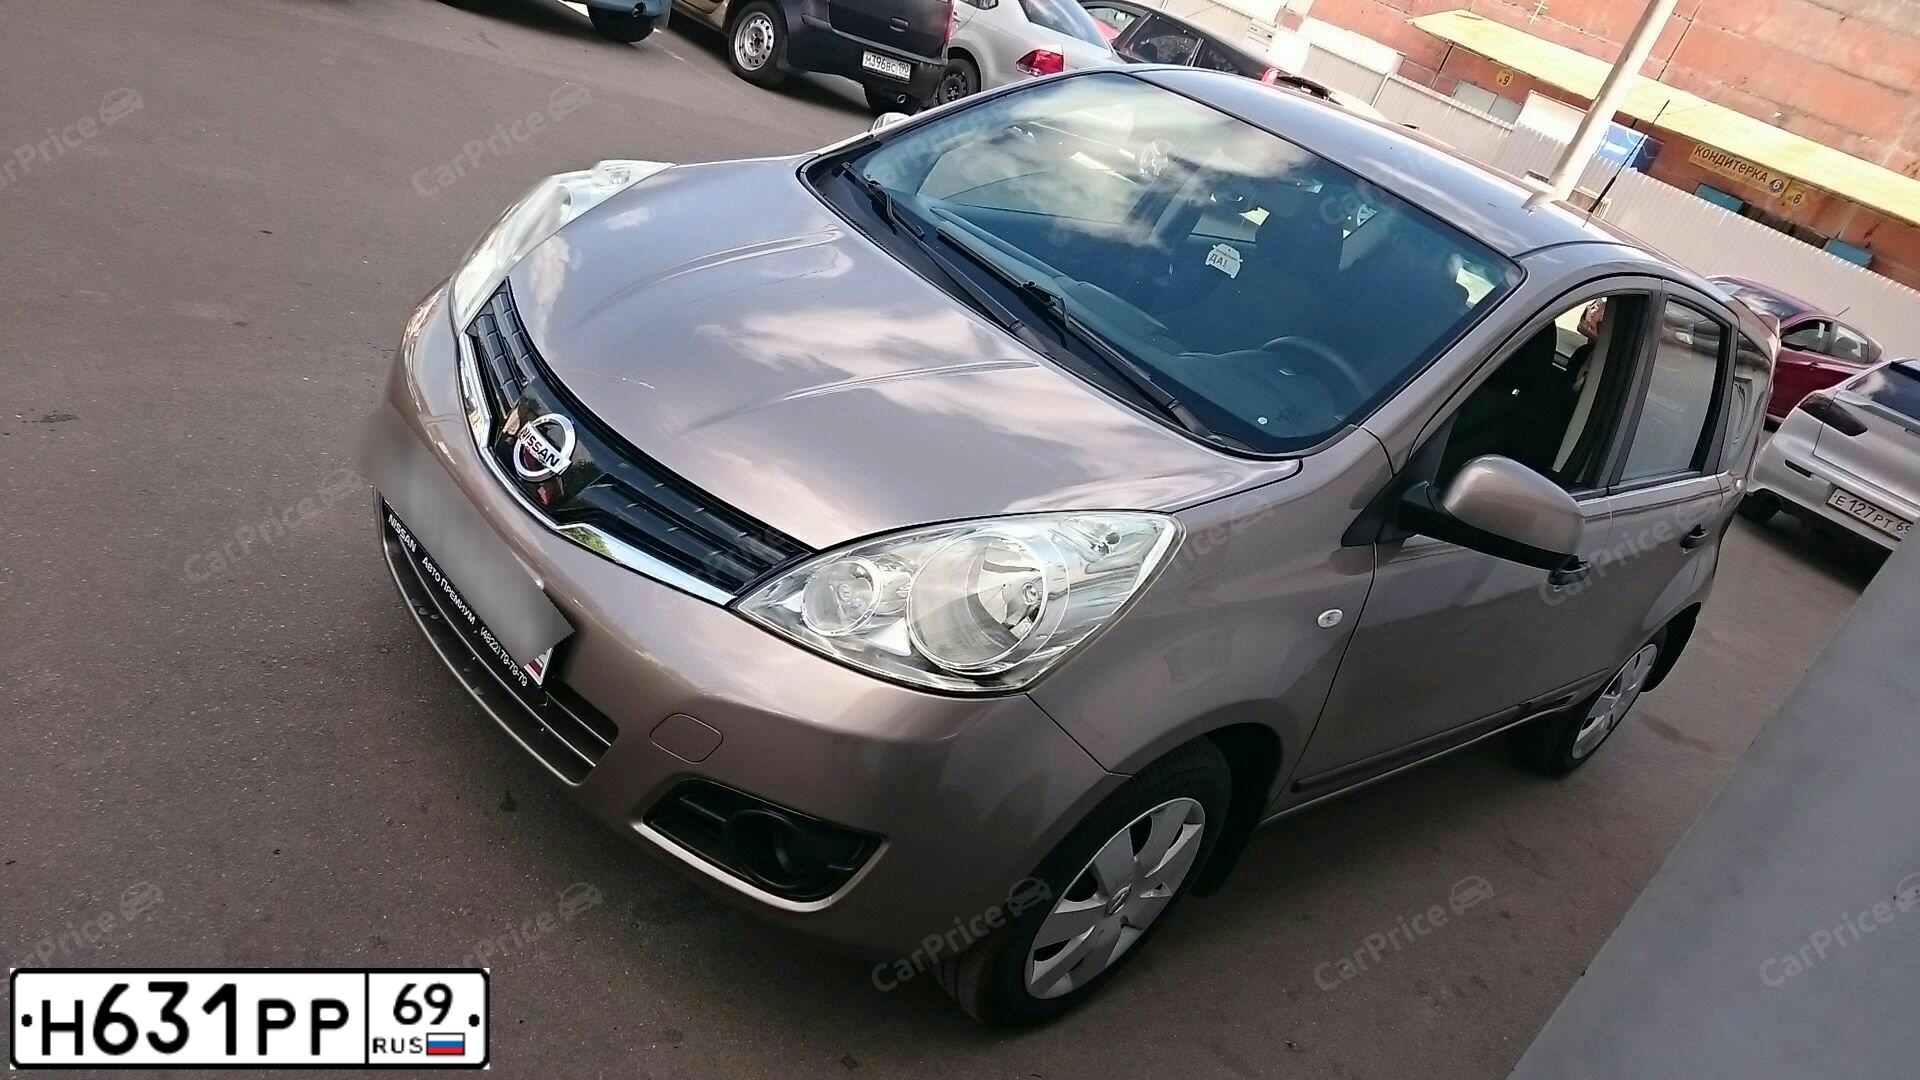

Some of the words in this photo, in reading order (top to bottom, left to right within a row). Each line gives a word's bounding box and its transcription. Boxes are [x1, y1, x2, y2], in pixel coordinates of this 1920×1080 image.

[520, 426, 561, 467] NISSAN
[388, 513, 418, 554] NISSAN
[440, 577, 476, 626] ПРЕМИУМ
